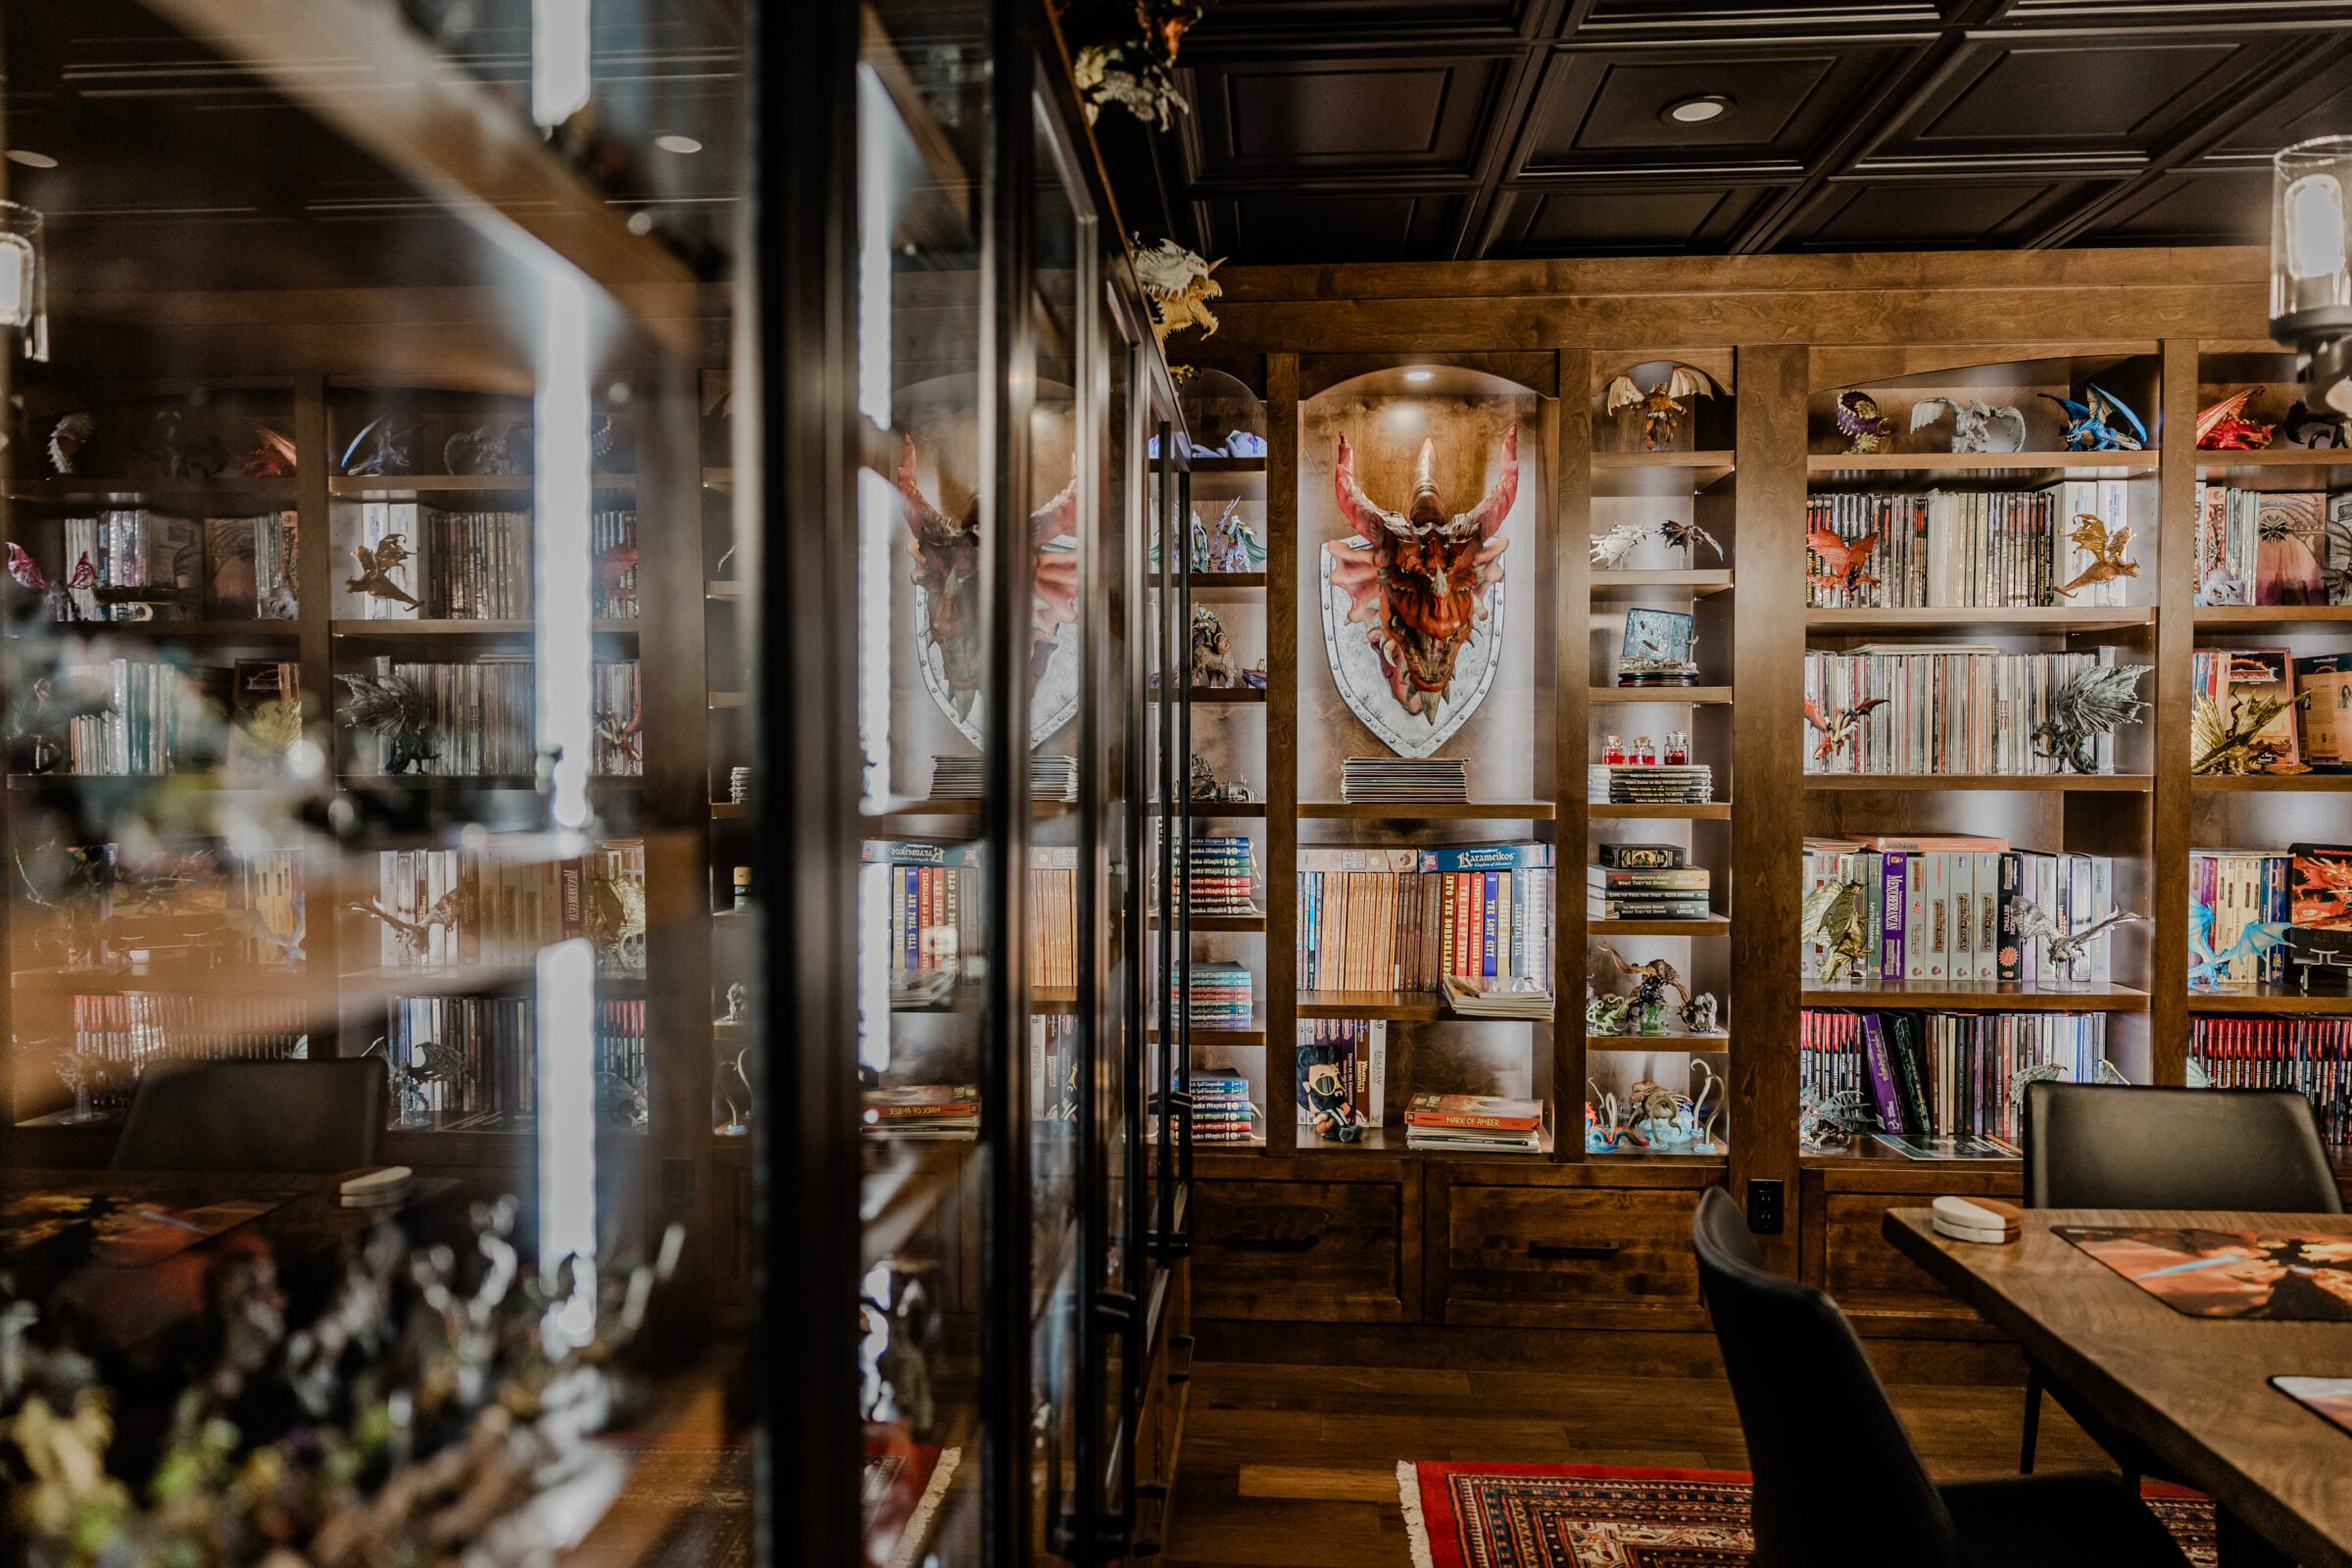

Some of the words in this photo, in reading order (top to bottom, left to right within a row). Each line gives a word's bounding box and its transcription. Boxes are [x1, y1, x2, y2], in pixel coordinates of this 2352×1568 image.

[1457, 851, 1515, 868] Karameikos
[1445, 875, 1454, 896] INTO
[1459, 885, 1468, 903] THE
[1445, 899, 1453, 915] THE
[1459, 905, 1468, 925] ISLE
[1487, 900, 1495, 915] THE
[1458, 926, 1467, 938] OF
[1486, 918, 1495, 937] LOST
[1485, 939, 1494, 957] CITY
[1446, 1116, 1465, 1125] MARK
[1477, 1118, 1500, 1127] AMBER
